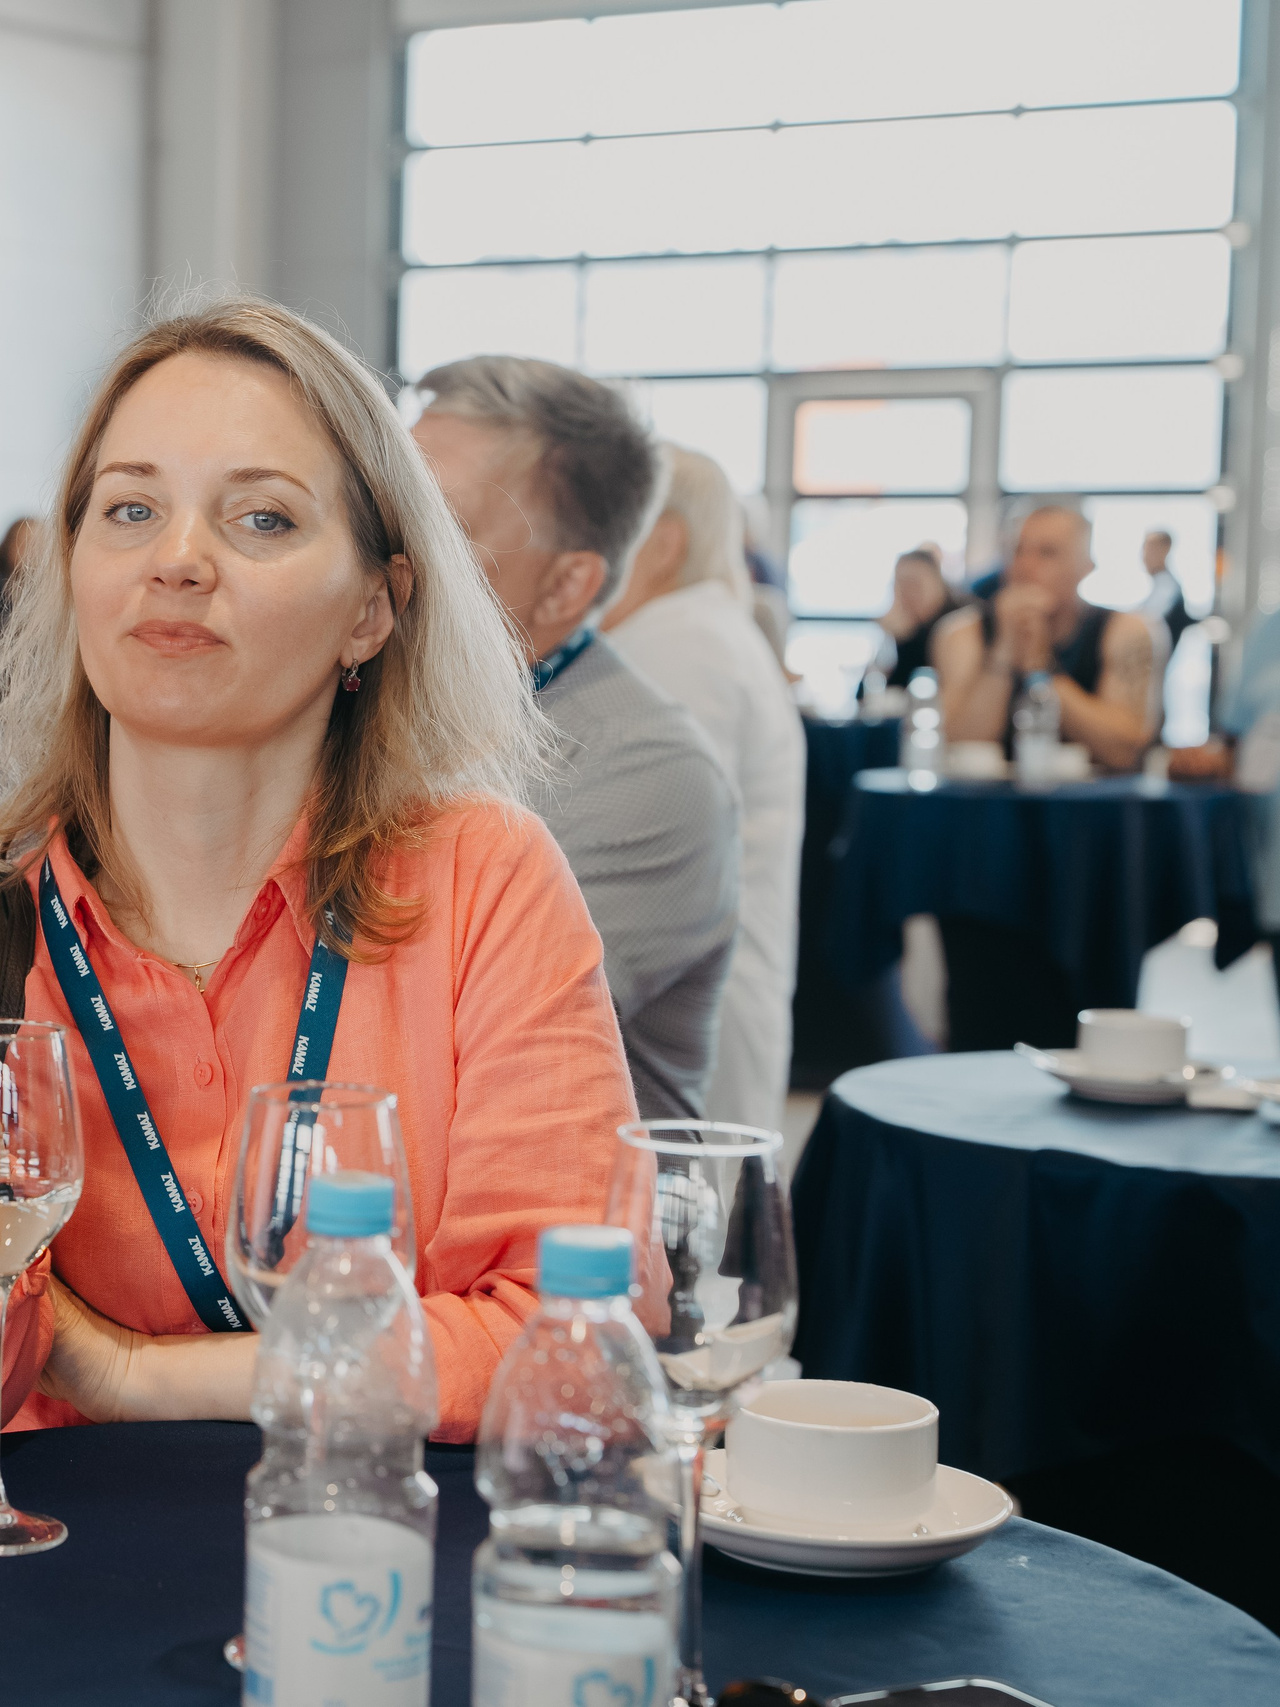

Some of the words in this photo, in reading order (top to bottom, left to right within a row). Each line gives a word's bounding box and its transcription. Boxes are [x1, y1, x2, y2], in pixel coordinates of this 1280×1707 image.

[51, 895, 68, 929] KAMAZ
[70, 943, 90, 977] KAMAZ
[305, 972, 322, 1011] KAMAZ
[91, 995, 113, 1030] KAMAZ
[114, 1052, 136, 1090] KAMAZ
[292, 1035, 309, 1075] KAMAZ
[137, 1111, 160, 1150] KAMAZ
[161, 1172, 185, 1212] KAMAZ
[188, 1235, 214, 1276] KAMAZ
[217, 1296, 242, 1329] KAMAZ
